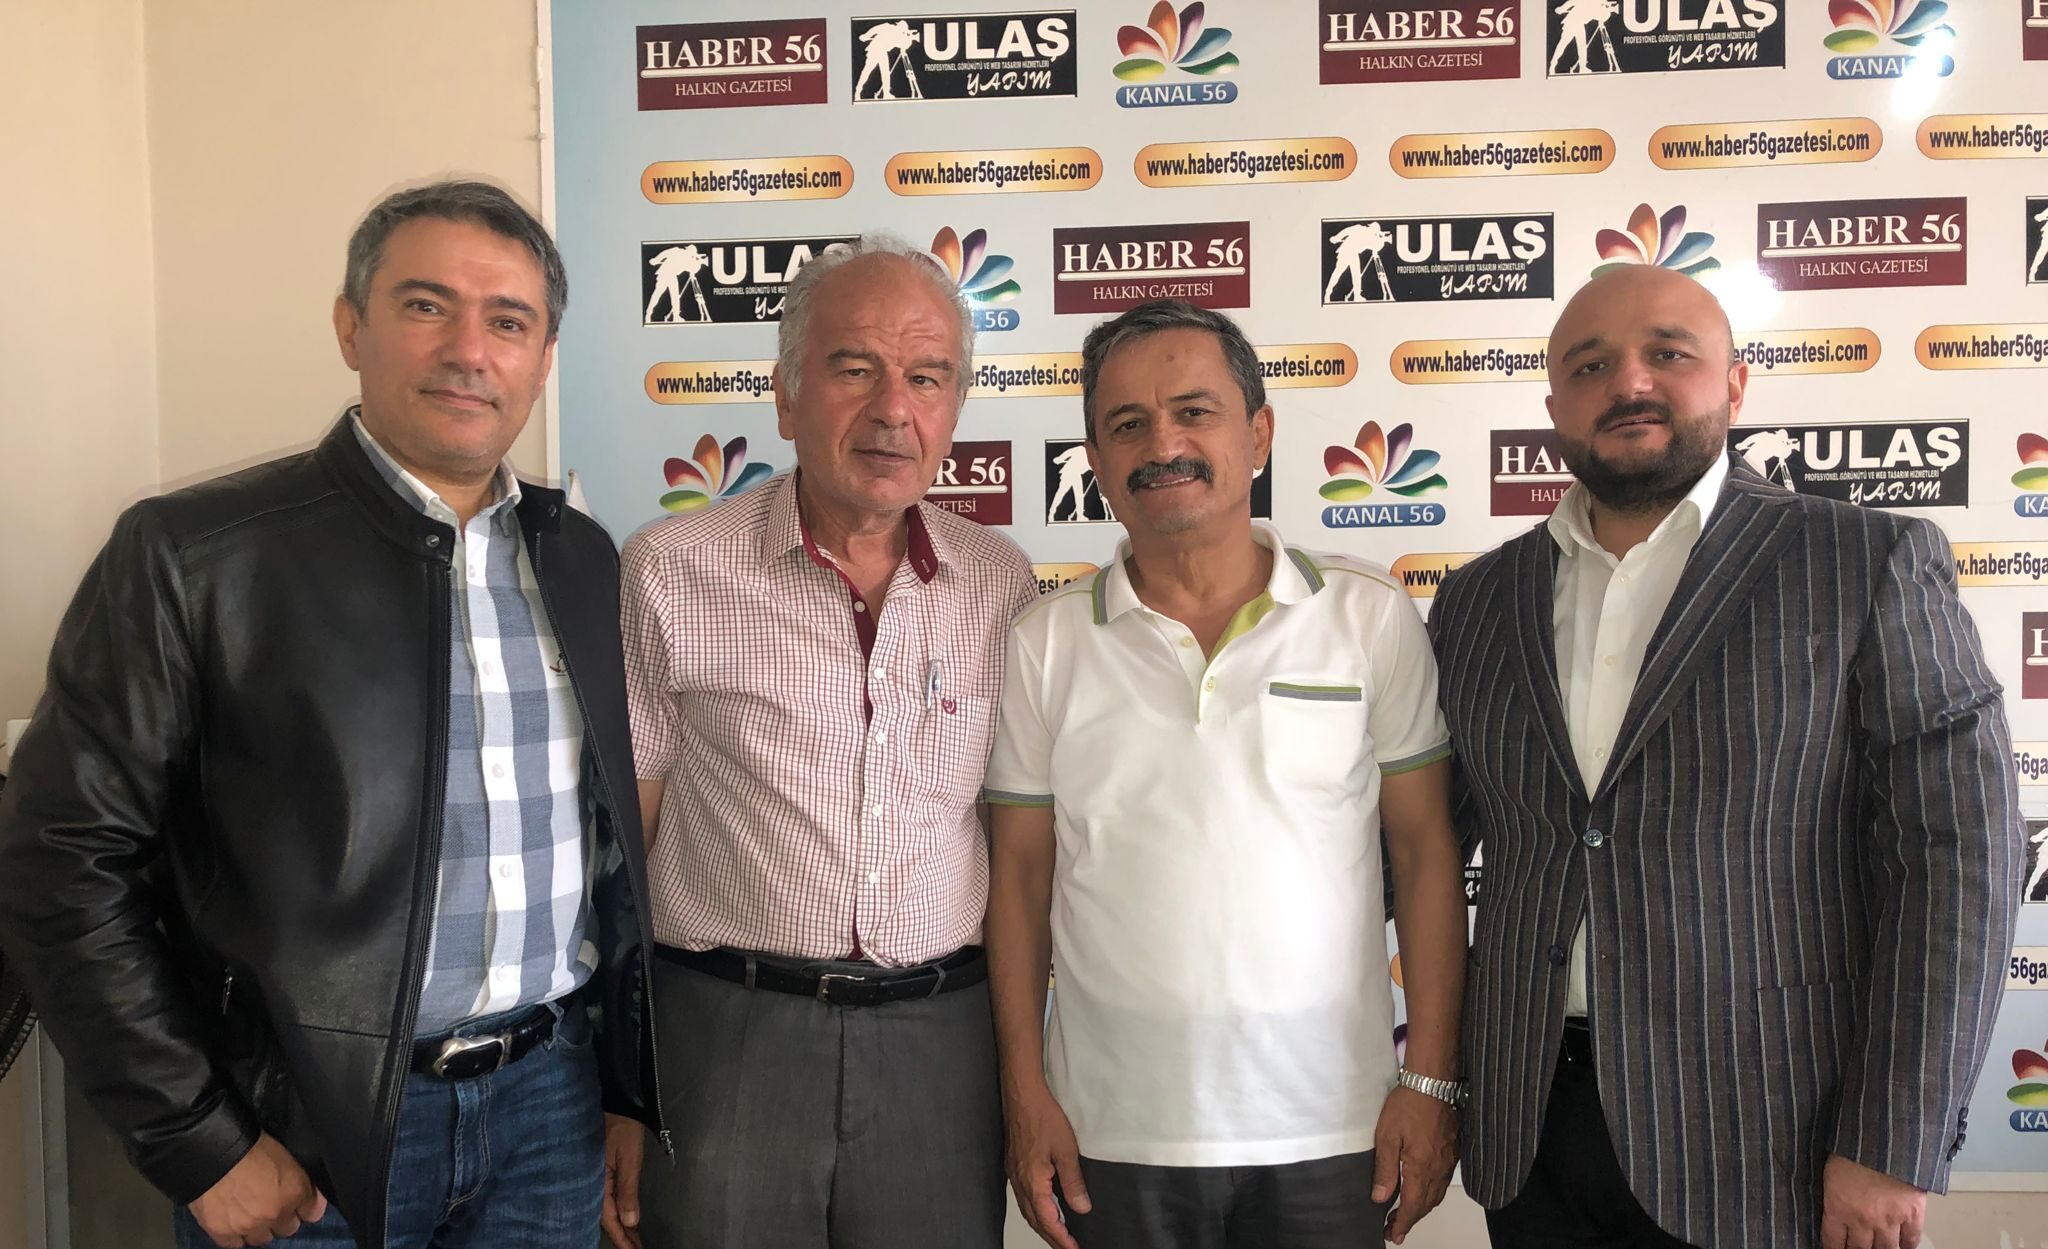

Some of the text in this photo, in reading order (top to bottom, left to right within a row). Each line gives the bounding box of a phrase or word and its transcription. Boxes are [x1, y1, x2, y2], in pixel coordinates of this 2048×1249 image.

[1328, 7, 1514, 43] HABER 56
[1623, 0, 1777, 33] ULAŞ
[644, 34, 821, 69] HABER 56
[923, 18, 1070, 62] ULAŞ
[1623, 34, 1657, 44] PROFESYONEL
[1686, 33, 1693, 41] VE
[1693, 32, 1704, 41] WEB
[1705, 31, 1726, 41] TASARIM
[924, 63, 957, 71] PROFESYONEL
[984, 62, 990, 70] VE
[990, 61, 1001, 69] WEB
[1001, 60, 1021, 69] TASARIM
[1359, 50, 1484, 70] HALKIN GAZETESİ
[1667, 41, 1758, 68] YAPIM
[675, 77, 793, 96] HALKIN GAZETESİ
[966, 70, 1051, 96] YAPIM
[1125, 83, 1227, 105] KANAL 56
[1402, 141, 1602, 170] www.haber56gazetesi.com
[1661, 129, 1870, 160] www.haber56gazetesi.com
[897, 159, 1090, 188] www.haber56gazetesi.com
[1146, 149, 1344, 178] www.haber56gazetesi.com
[653, 167, 842, 196] www.haber56gazetesi.com
[1396, 220, 1546, 265] ULAŞ
[1766, 213, 1961, 249] HABER 56
[711, 243, 852, 285] ULA
[1061, 237, 1245, 272] HABER 56
[1396, 265, 1430, 274] PROFESYONEL
[1458, 263, 1464, 272] VE
[1465, 263, 1475, 272] WEB
[1476, 262, 1496, 271] TASARIM
[1800, 256, 1929, 277] HALKIN GAZETESİ
[713, 288, 744, 296] PROFESYONEL
[771, 286, 777, 294] VE
[1093, 281, 1214, 300] HALKIN GAZETESİ
[1440, 273, 1528, 299] YAPIM
[985, 311, 1009, 329] 56
[1403, 347, 1545, 376] www.haber56gazet
[1804, 427, 1961, 472] ULAŞ
[970, 456, 1006, 485] 56
[1804, 472, 1839, 482] PROFESYONEL
[1868, 471, 1874, 480] VE
[1876, 471, 1887, 479] WEB
[1887, 469, 1909, 480] TASARIM
[1850, 481, 1941, 506] YAPIM
[1332, 505, 1435, 525] KANAL 56
